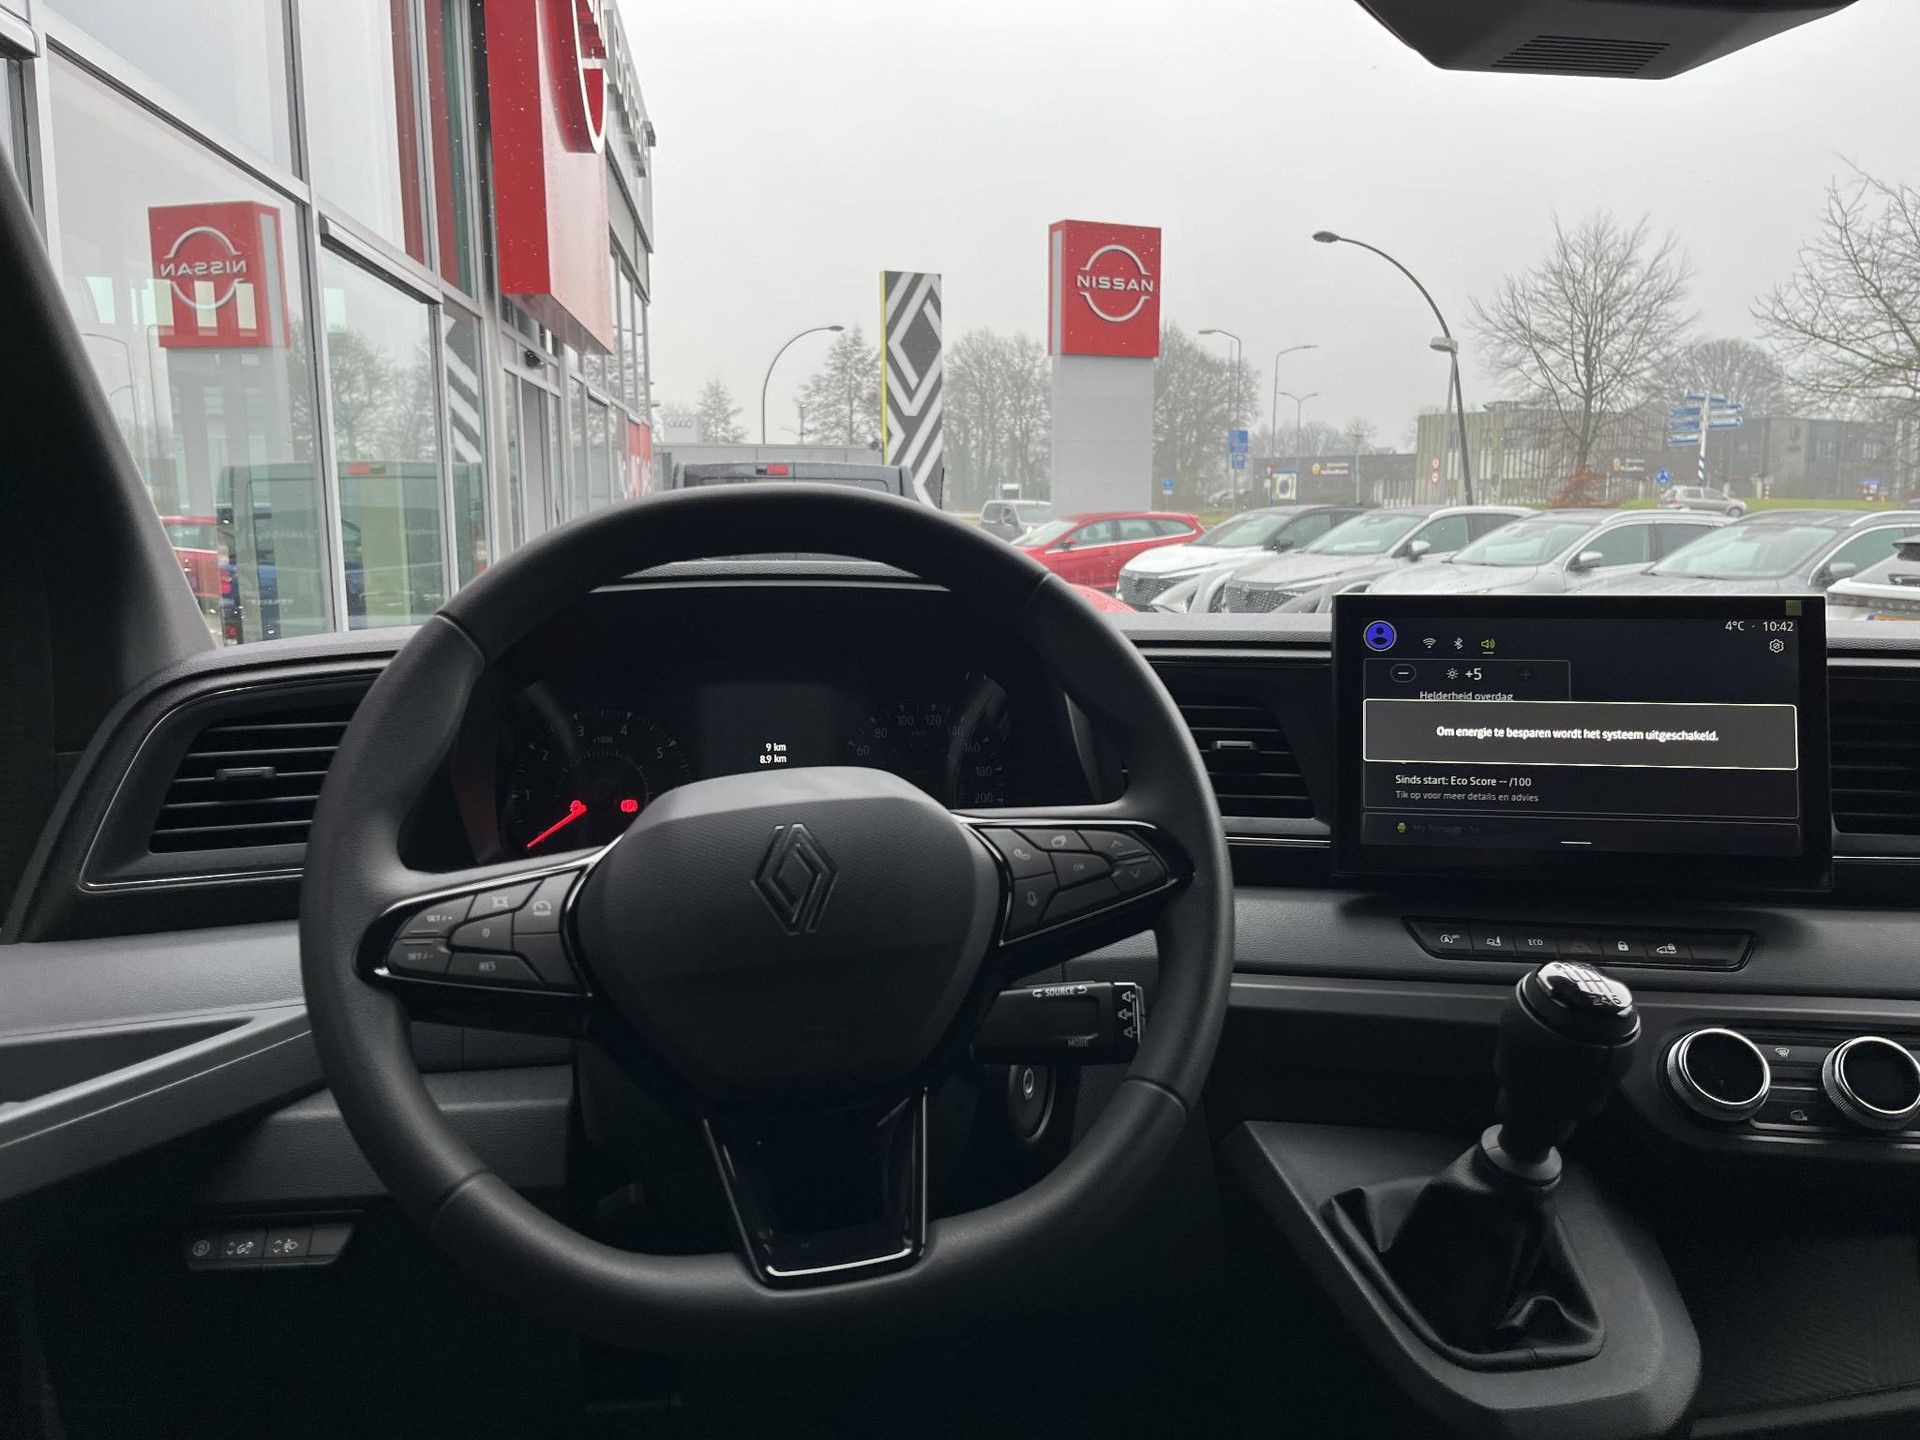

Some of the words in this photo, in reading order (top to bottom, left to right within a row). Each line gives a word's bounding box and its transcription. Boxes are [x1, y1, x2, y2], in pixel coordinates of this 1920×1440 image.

[1076, 275, 1154, 292] NISSAN
[1724, 621, 1744, 631] 4°C
[1762, 621, 1794, 632] 10:42
[1465, 667, 1482, 681] +5
[1420, 691, 1473, 700] Helderheid
[1474, 692, 1513, 701] overdag
[578, 725, 585, 737] 3
[620, 724, 629, 736] 4
[1436, 726, 1455, 737] Om
[1455, 727, 1493, 739] energie
[1493, 727, 1505, 738] te
[1505, 727, 1552, 740] besparen
[1552, 728, 1582, 739] wordt
[1583, 729, 1601, 739] het
[1601, 730, 1644, 741] systeem
[1645, 730, 1719, 742] uitgeschakeld.
[656, 747, 664, 760] 5
[765, 742, 772, 752] 9
[773, 742, 787, 752] km
[759, 754, 772, 764] 8.9
[773, 754, 787, 763] km
[1395, 775, 1422, 784] Sinds
[1422, 776, 1449, 785] start:
[1450, 776, 1468, 786] Eco
[1469, 777, 1498, 787] Score
[1508, 778, 1532, 788] /100
[1394, 790, 1409, 799] Tik
[1409, 792, 1421, 801] op
[1422, 792, 1442, 800] voor
[1442, 793, 1466, 801] meer
[1466, 791, 1497, 802] details
[1497, 794, 1510, 802] en
[1510, 793, 1540, 803] advies
[1527, 938, 1544, 946] ECO
[1044, 986, 1076, 997] SOURCE
